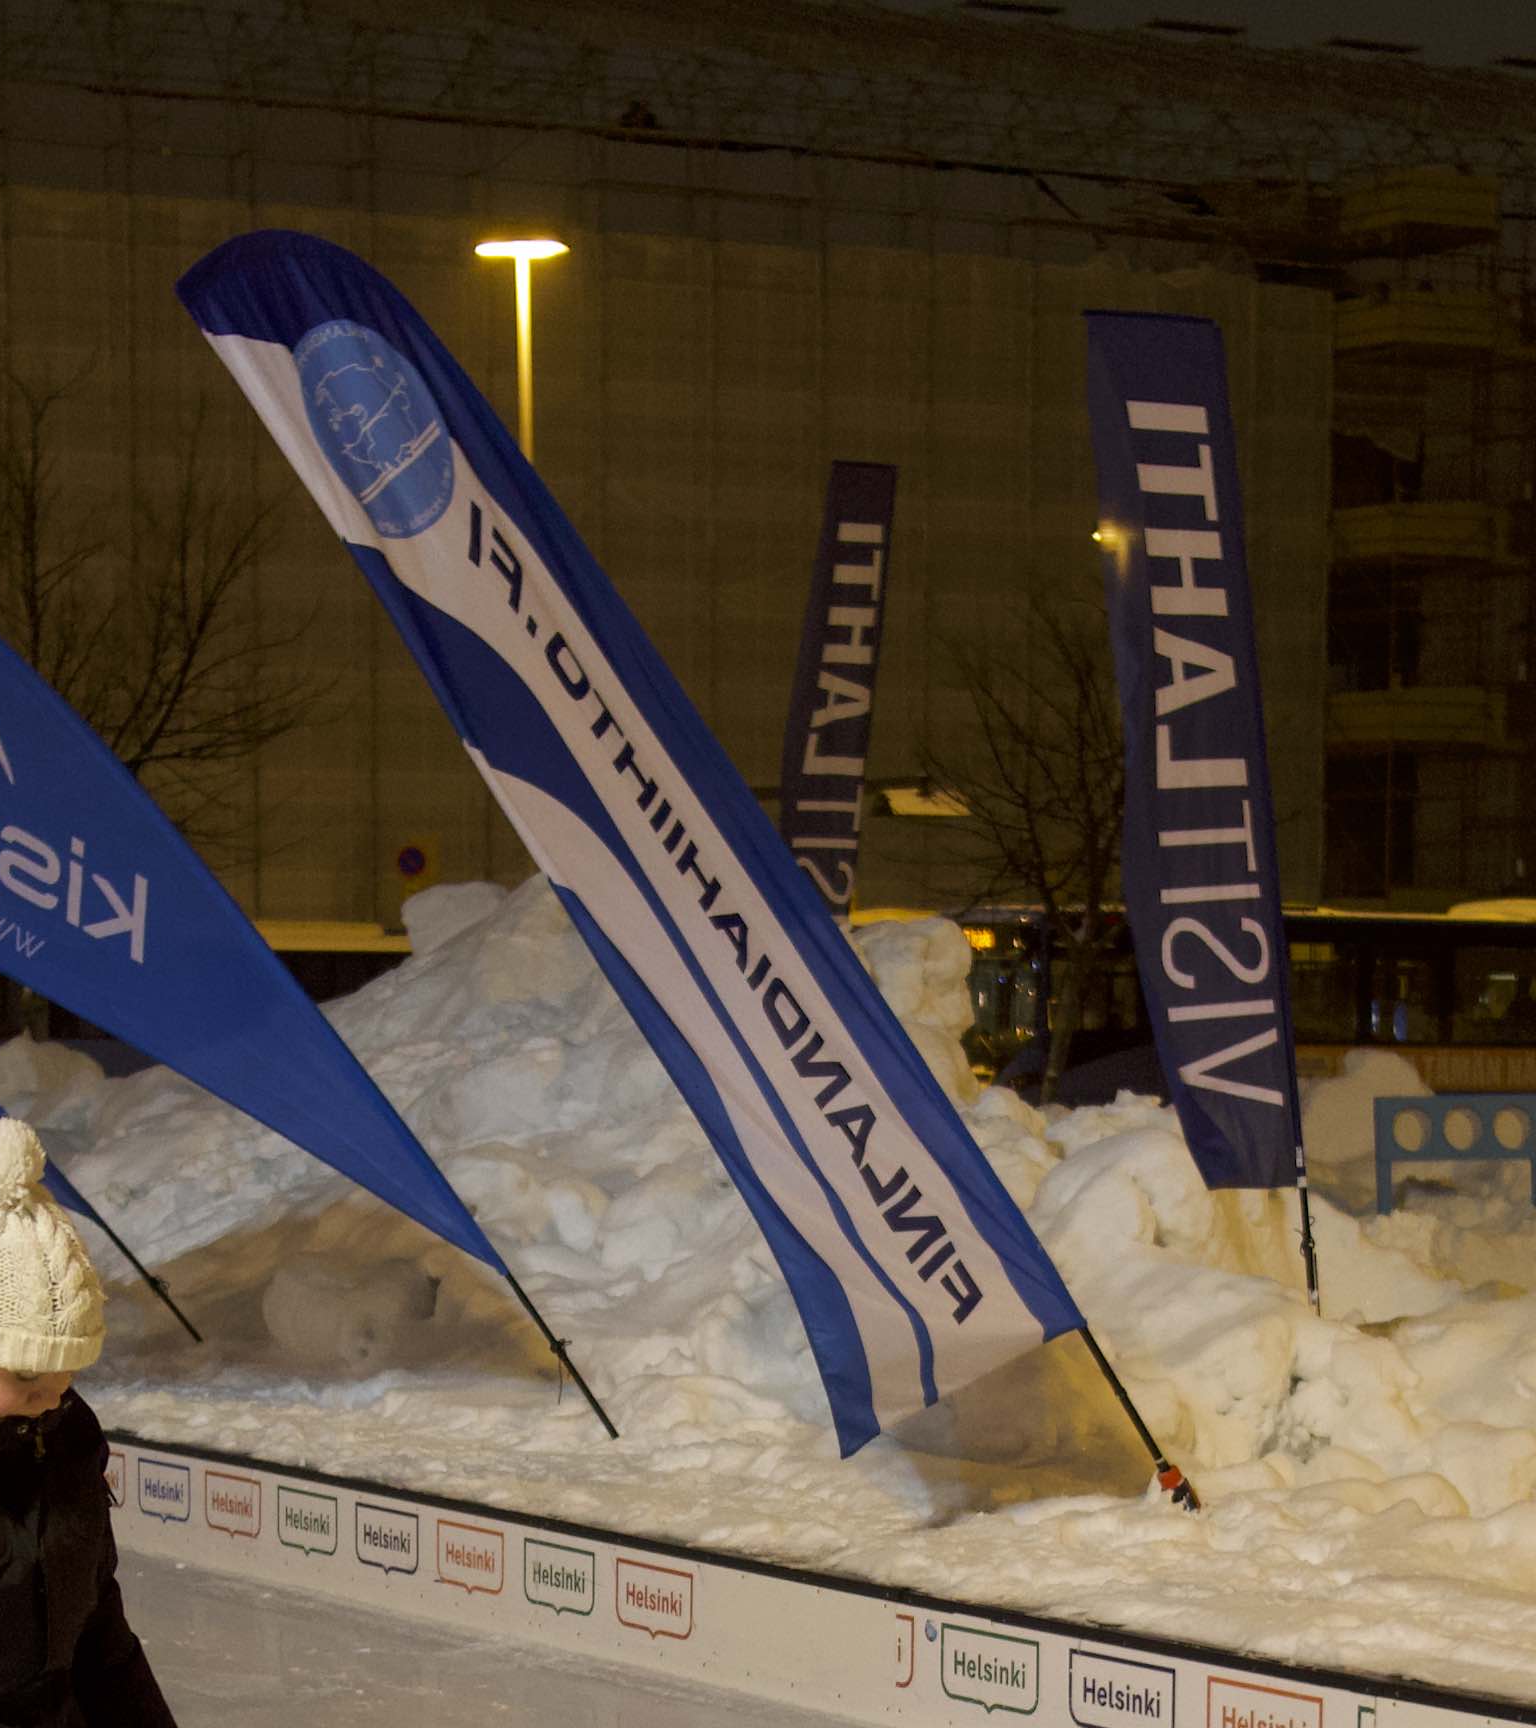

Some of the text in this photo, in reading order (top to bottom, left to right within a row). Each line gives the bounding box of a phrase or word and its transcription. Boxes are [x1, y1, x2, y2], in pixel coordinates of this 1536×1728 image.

[144, 1478, 184, 1504] Helsinki
[212, 1491, 253, 1518] Helsinki
[284, 1506, 330, 1536] Helsinki
[363, 1523, 411, 1554] Helsinki
[445, 1542, 495, 1573] Helsinki
[532, 1560, 586, 1594] Helsinki
[625, 1581, 683, 1617] Helsinki
[952, 1650, 1026, 1690] Helsinki
[1081, 1676, 1161, 1719] Helsinki
